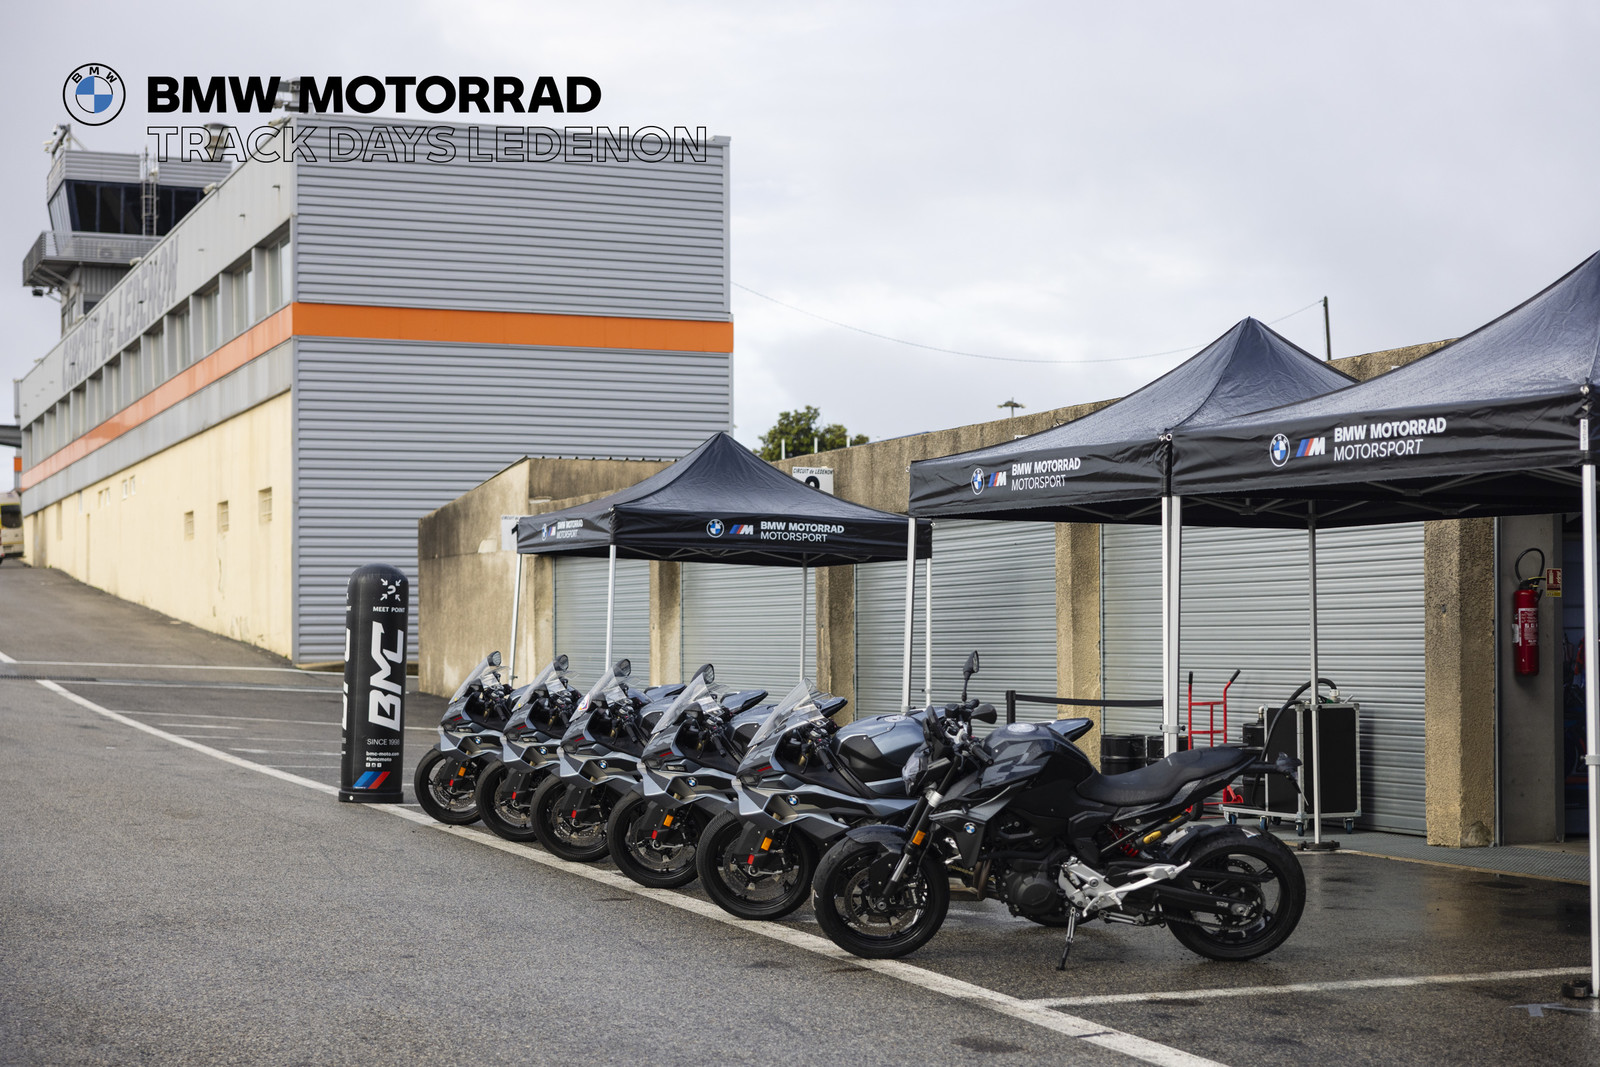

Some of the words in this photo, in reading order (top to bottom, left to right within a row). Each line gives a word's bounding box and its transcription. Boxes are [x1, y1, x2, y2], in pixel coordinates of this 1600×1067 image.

[1334, 425, 1367, 443] BMW
[1370, 417, 1447, 439] MOTORRAD
[1333, 439, 1424, 461] MOTORSPORT
[1011, 462, 1033, 476] BMW
[1034, 457, 1081, 474] MOTORRAD
[1011, 474, 1066, 491] MOTORSPORT
[760, 521, 786, 531] BMW
[788, 522, 845, 534] MOTORRAD
[760, 531, 828, 542] MOTORSPORT
[368, 620, 404, 732] BMC
[366, 738, 387, 746] SINCE
